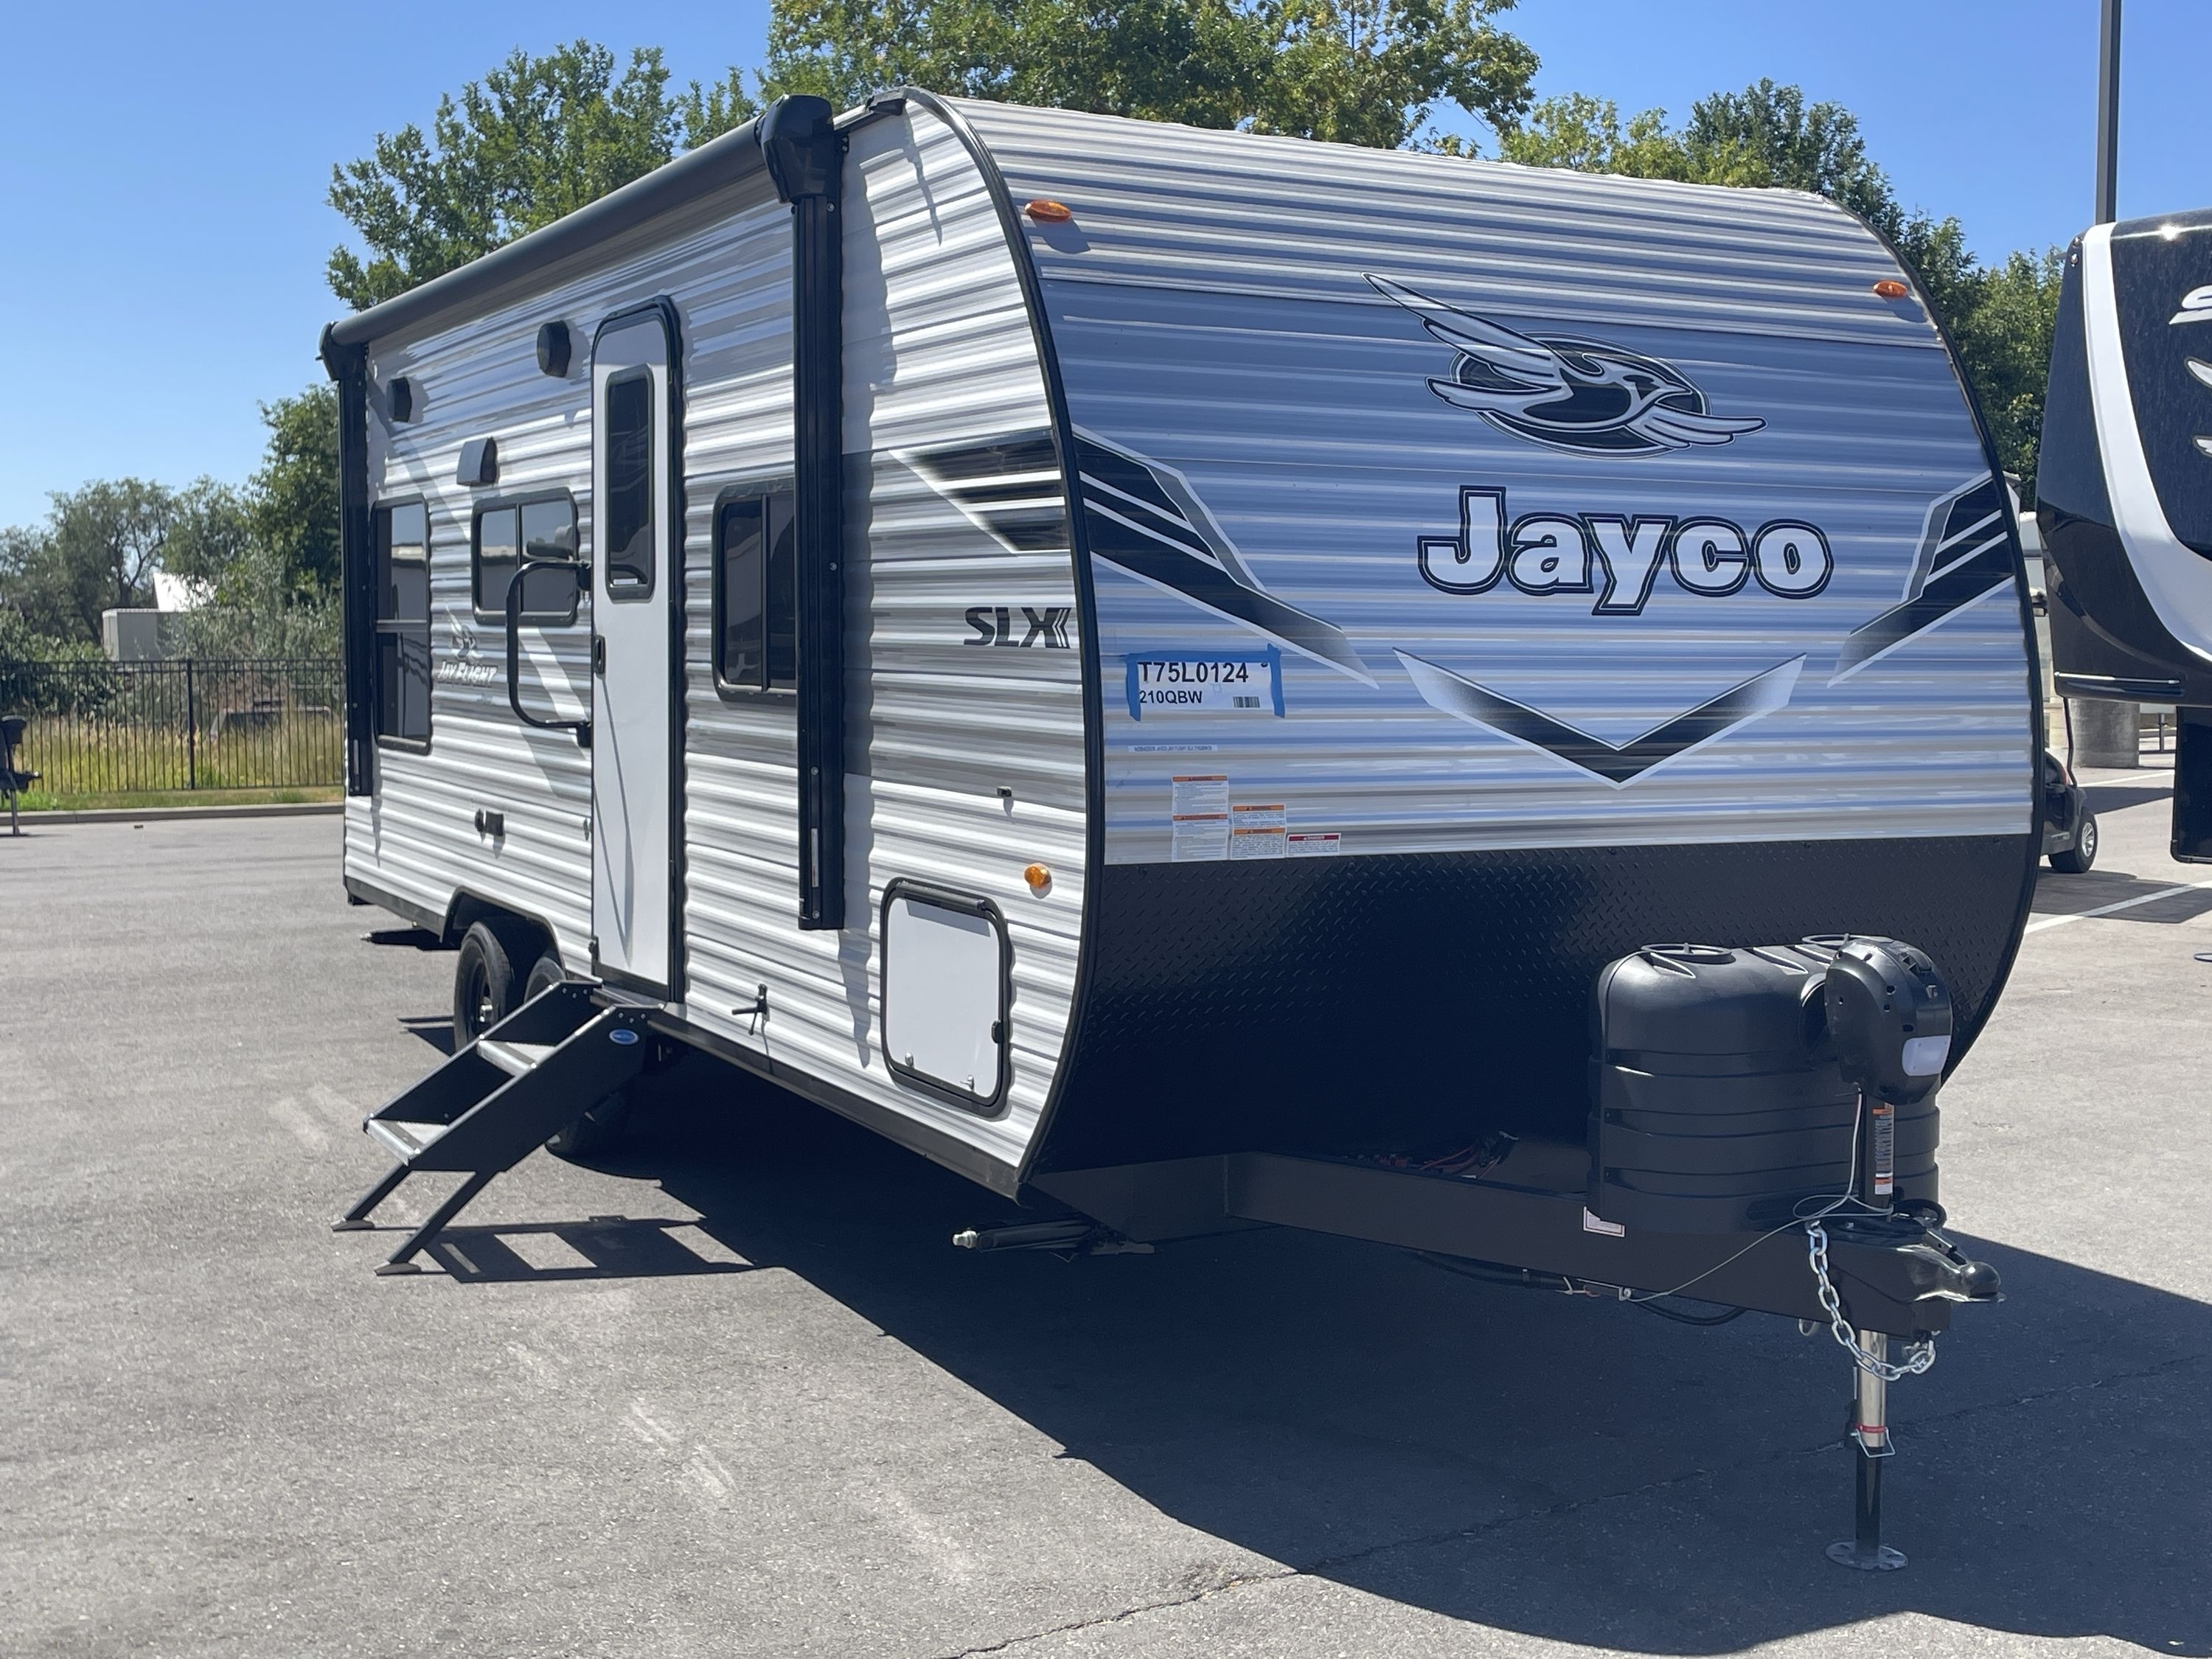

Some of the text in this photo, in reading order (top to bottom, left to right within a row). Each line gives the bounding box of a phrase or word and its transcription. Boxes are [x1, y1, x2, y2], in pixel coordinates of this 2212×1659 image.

[1416, 484, 1835, 616] Jayco
[963, 606, 1072, 649] SLX
[1138, 661, 1249, 683] T75L0124
[1139, 690, 1203, 704] 210QBW
